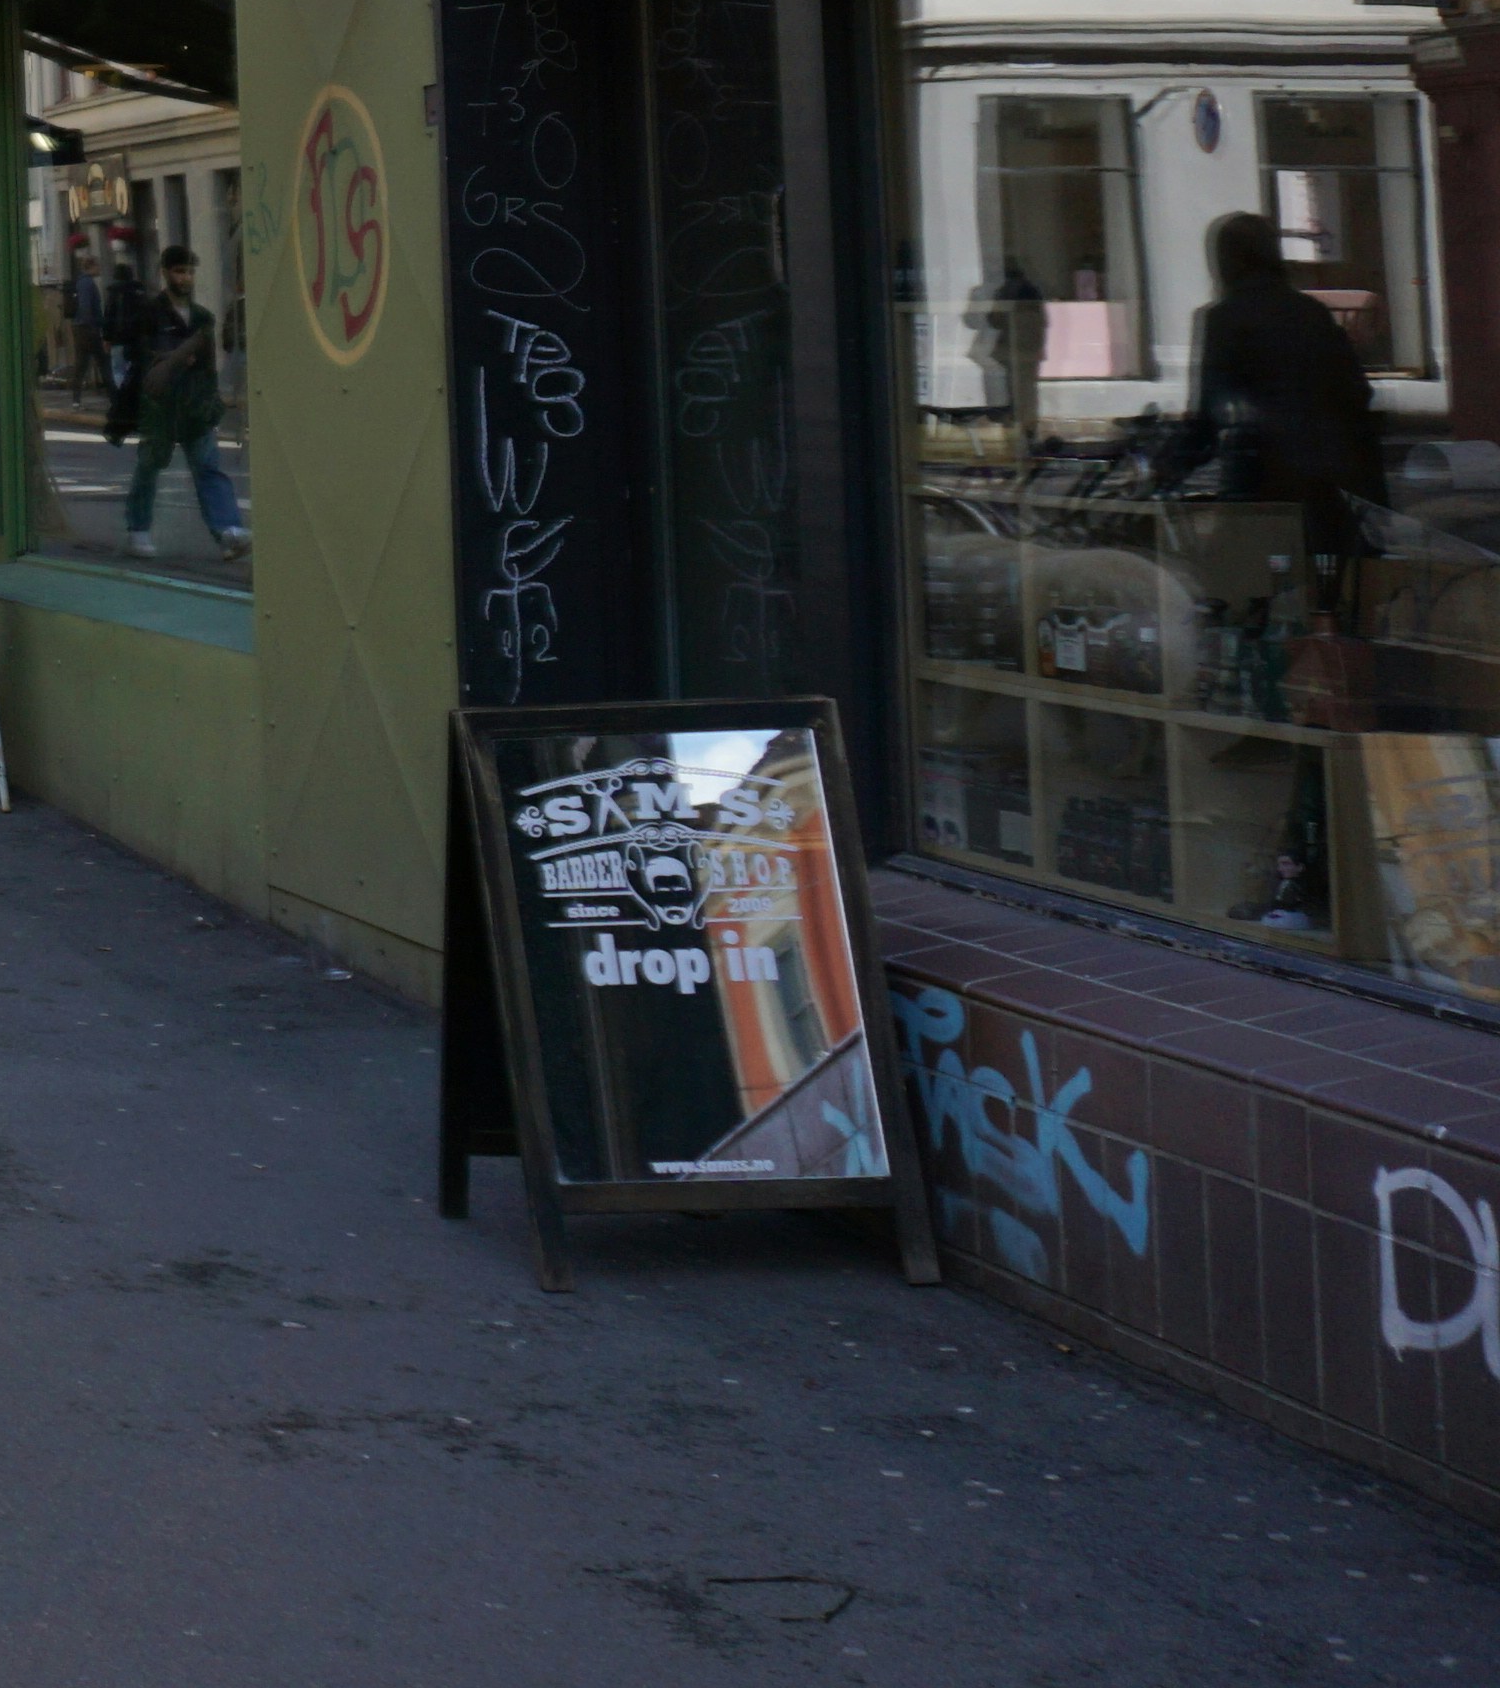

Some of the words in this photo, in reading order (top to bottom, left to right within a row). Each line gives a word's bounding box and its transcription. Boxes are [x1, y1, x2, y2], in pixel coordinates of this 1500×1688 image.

[542, 850, 628, 891] BARBER
[709, 850, 795, 886] SHOP
[566, 902, 620, 919] since
[728, 896, 773, 914] 2009
[585, 932, 711, 995] drop
[723, 929, 780, 983] in
